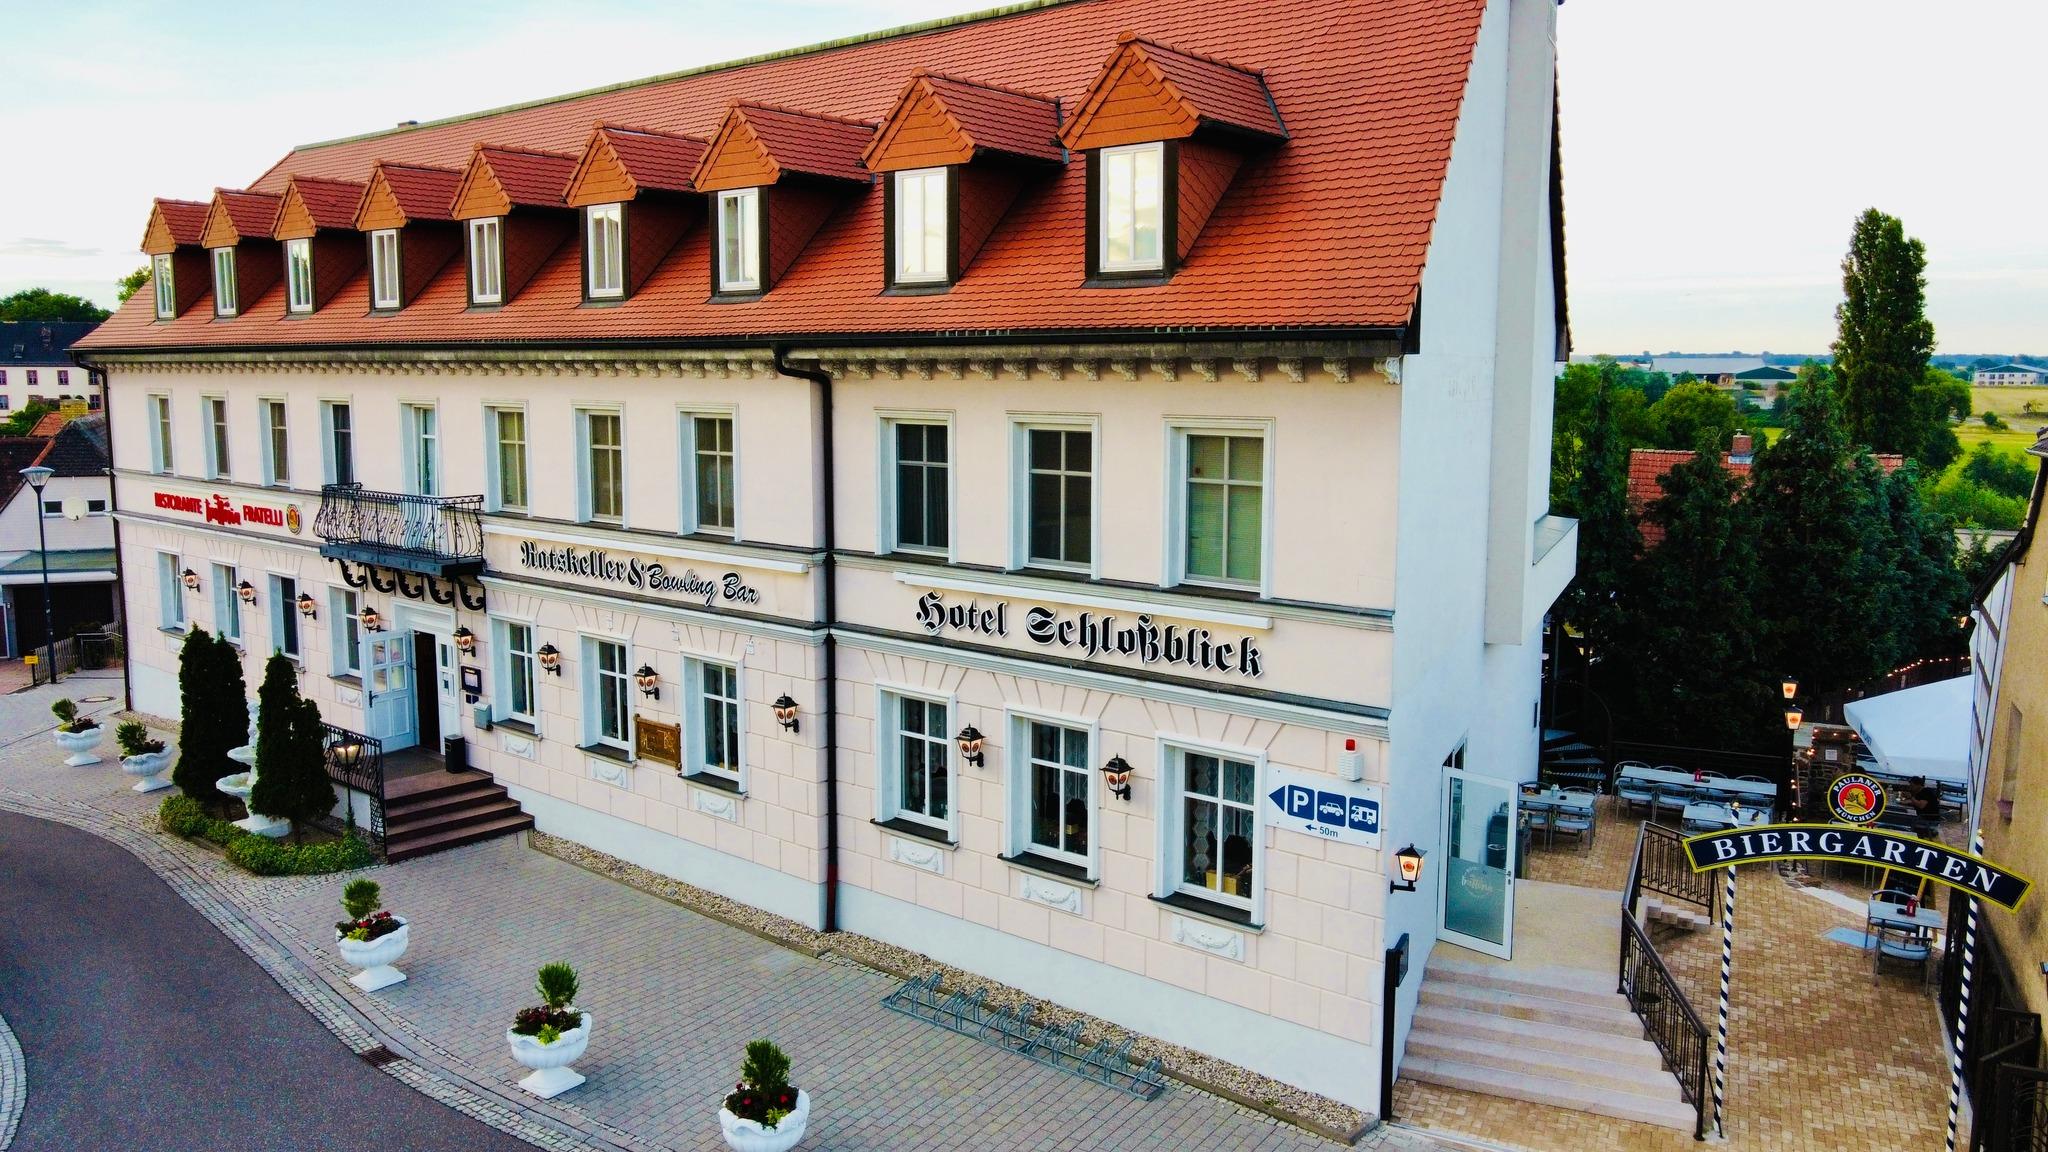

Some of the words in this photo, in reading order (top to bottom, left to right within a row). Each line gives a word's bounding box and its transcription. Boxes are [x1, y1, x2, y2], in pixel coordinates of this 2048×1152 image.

[154, 492, 203, 515] RISTORANTE
[242, 504, 284, 527] FRATELLI
[520, 540, 626, 583] Ratskeller
[646, 562, 717, 607] Bowling
[722, 570, 760, 604] Bar
[915, 588, 1008, 638] Hotel
[1024, 606, 1265, 680] Schloßblick
[1833, 776, 1882, 796] PAULANER
[1292, 789, 1310, 814] P
[1834, 806, 1877, 822] MÜNCHEN
[1319, 825, 1339, 838] 50m
[1712, 831, 2001, 893] BIERGARTEN
